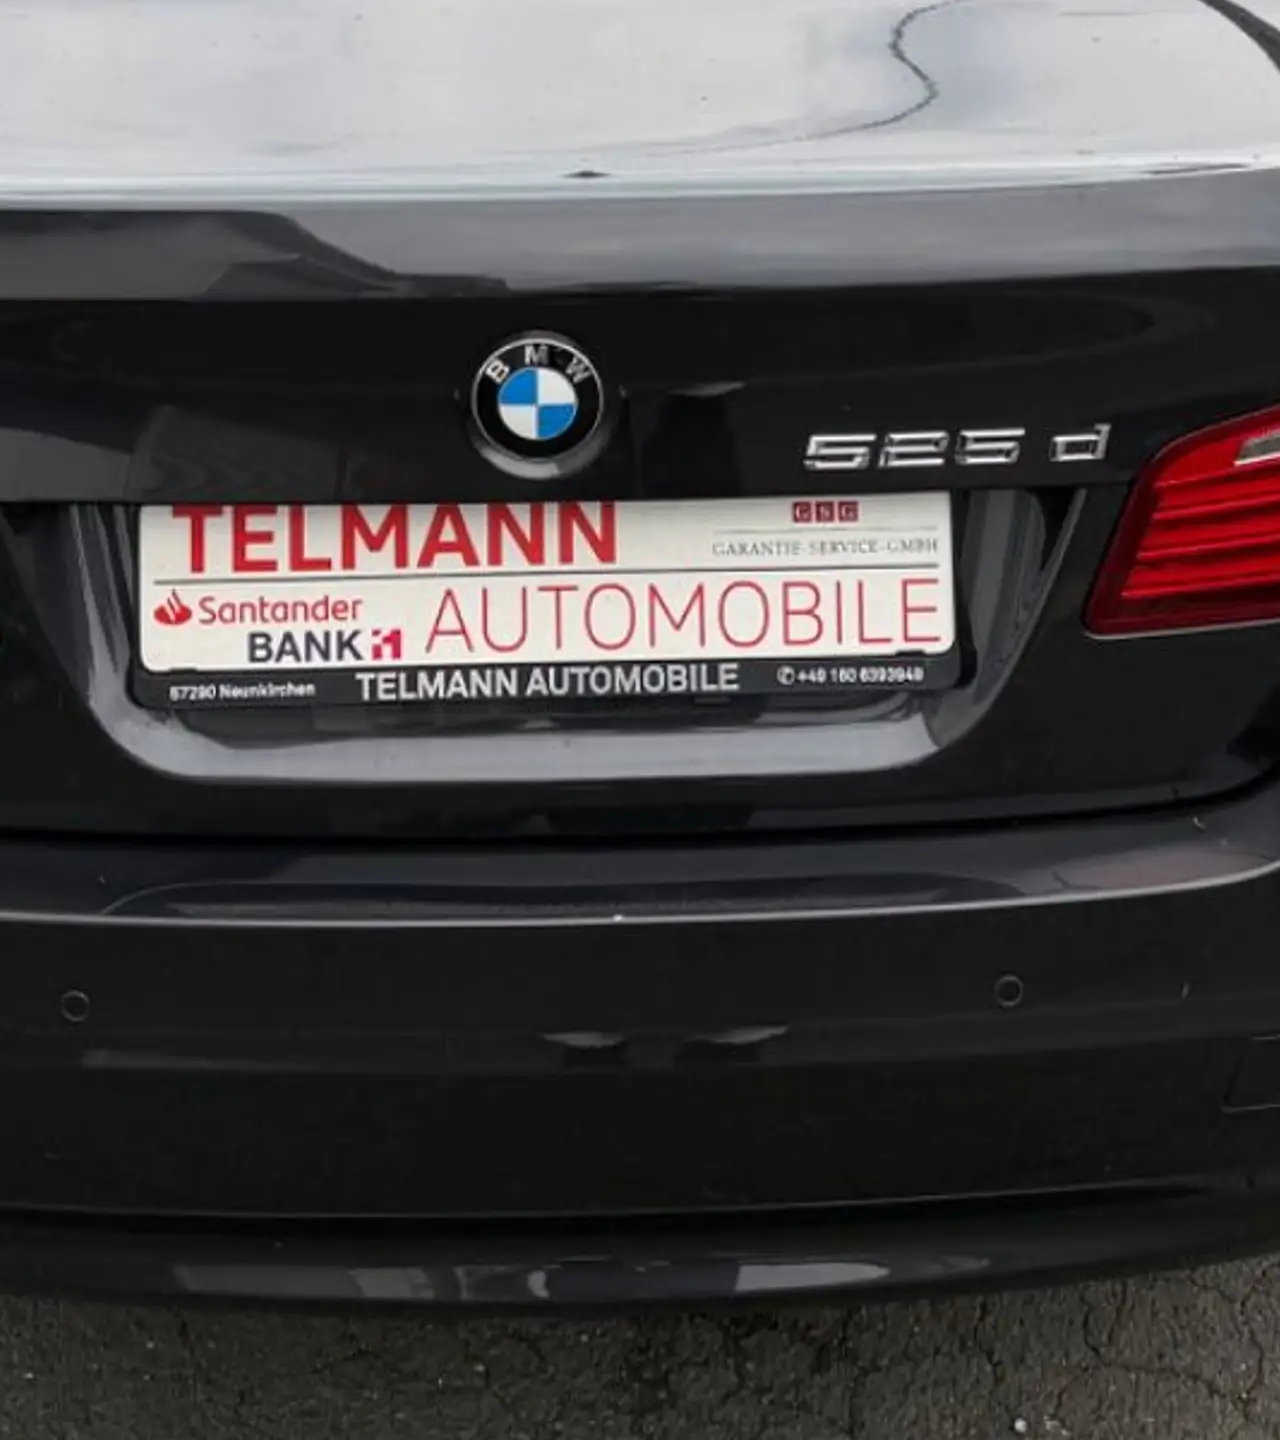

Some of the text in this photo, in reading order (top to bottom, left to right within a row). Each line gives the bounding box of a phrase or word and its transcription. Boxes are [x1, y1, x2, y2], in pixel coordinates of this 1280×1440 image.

[485, 344, 593, 385] BMW
[803, 422, 1113, 471] 525 d
[172, 501, 616, 573] TELMANN
[198, 594, 363, 626] Santander
[425, 577, 942, 654] AUTOMOBILE
[219, 680, 317, 700] Neunkirchen
[356, 662, 741, 701] TELMANN AUTOMOBILE
